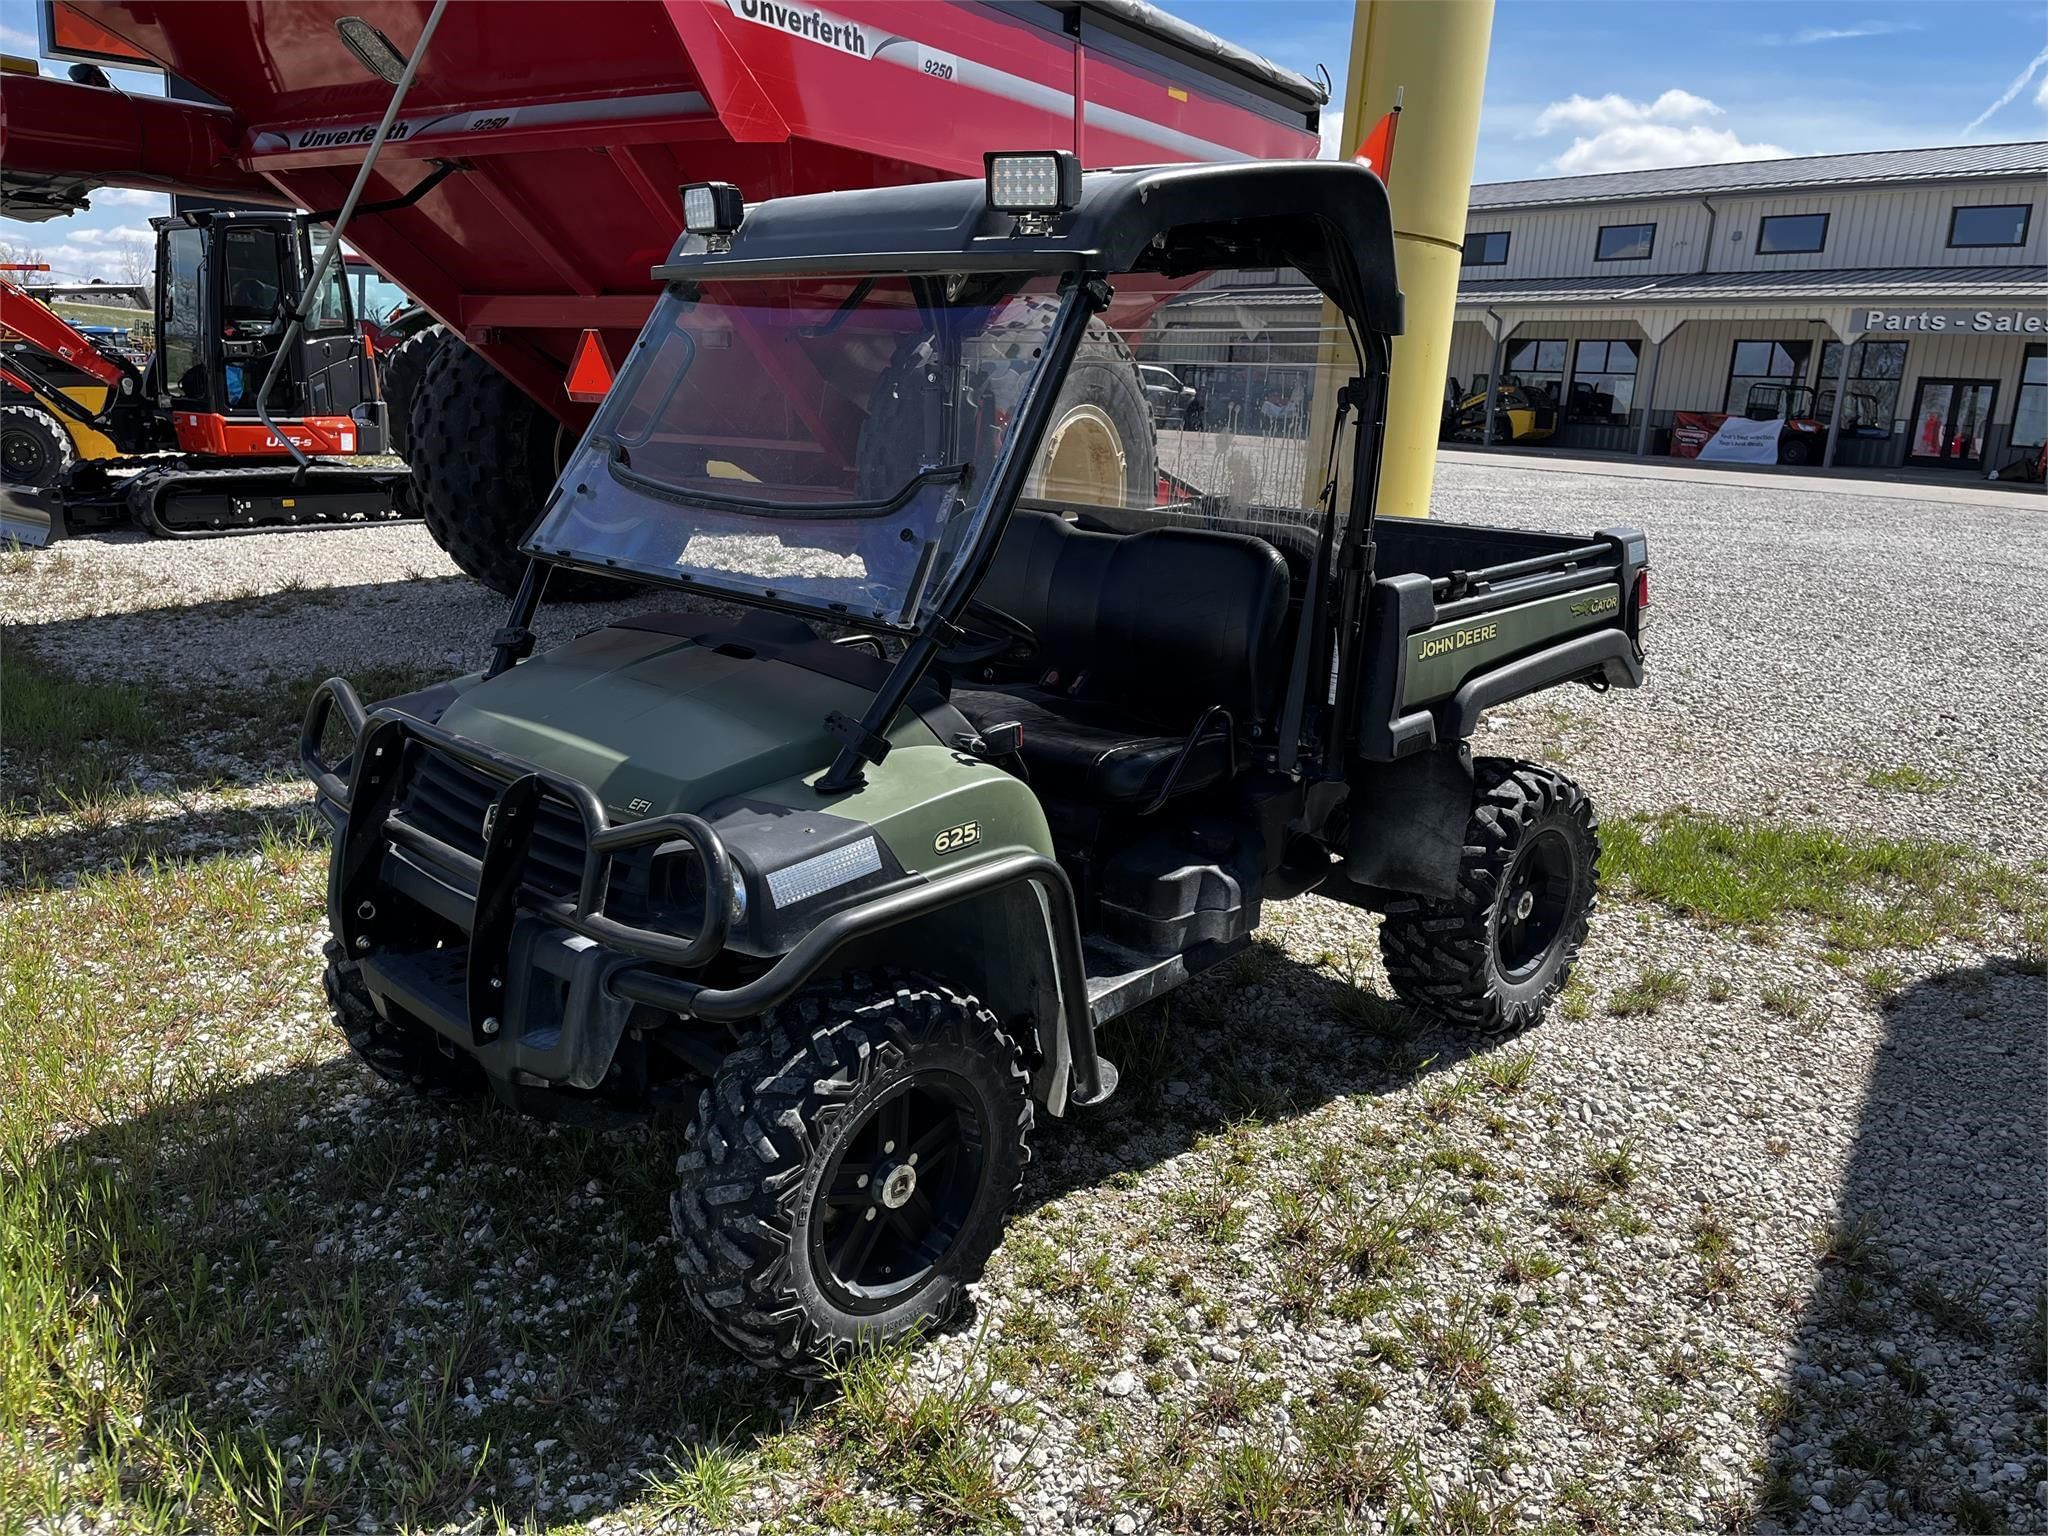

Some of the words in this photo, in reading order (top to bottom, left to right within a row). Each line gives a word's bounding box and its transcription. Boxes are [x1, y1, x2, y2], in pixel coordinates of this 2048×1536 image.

[740, 0, 866, 55] Unverferth
[923, 59, 953, 80] 9250
[469, 116, 510, 131] 9250
[298, 122, 409, 148] Unverfeth
[1865, 311, 1947, 331] Parts
[1591, 597, 1618, 613] GATOR
[1418, 636, 1455, 660] JOHN
[1456, 624, 1498, 649] DEERE
[628, 798, 653, 813] EFI
[935, 822, 980, 851] 625i
